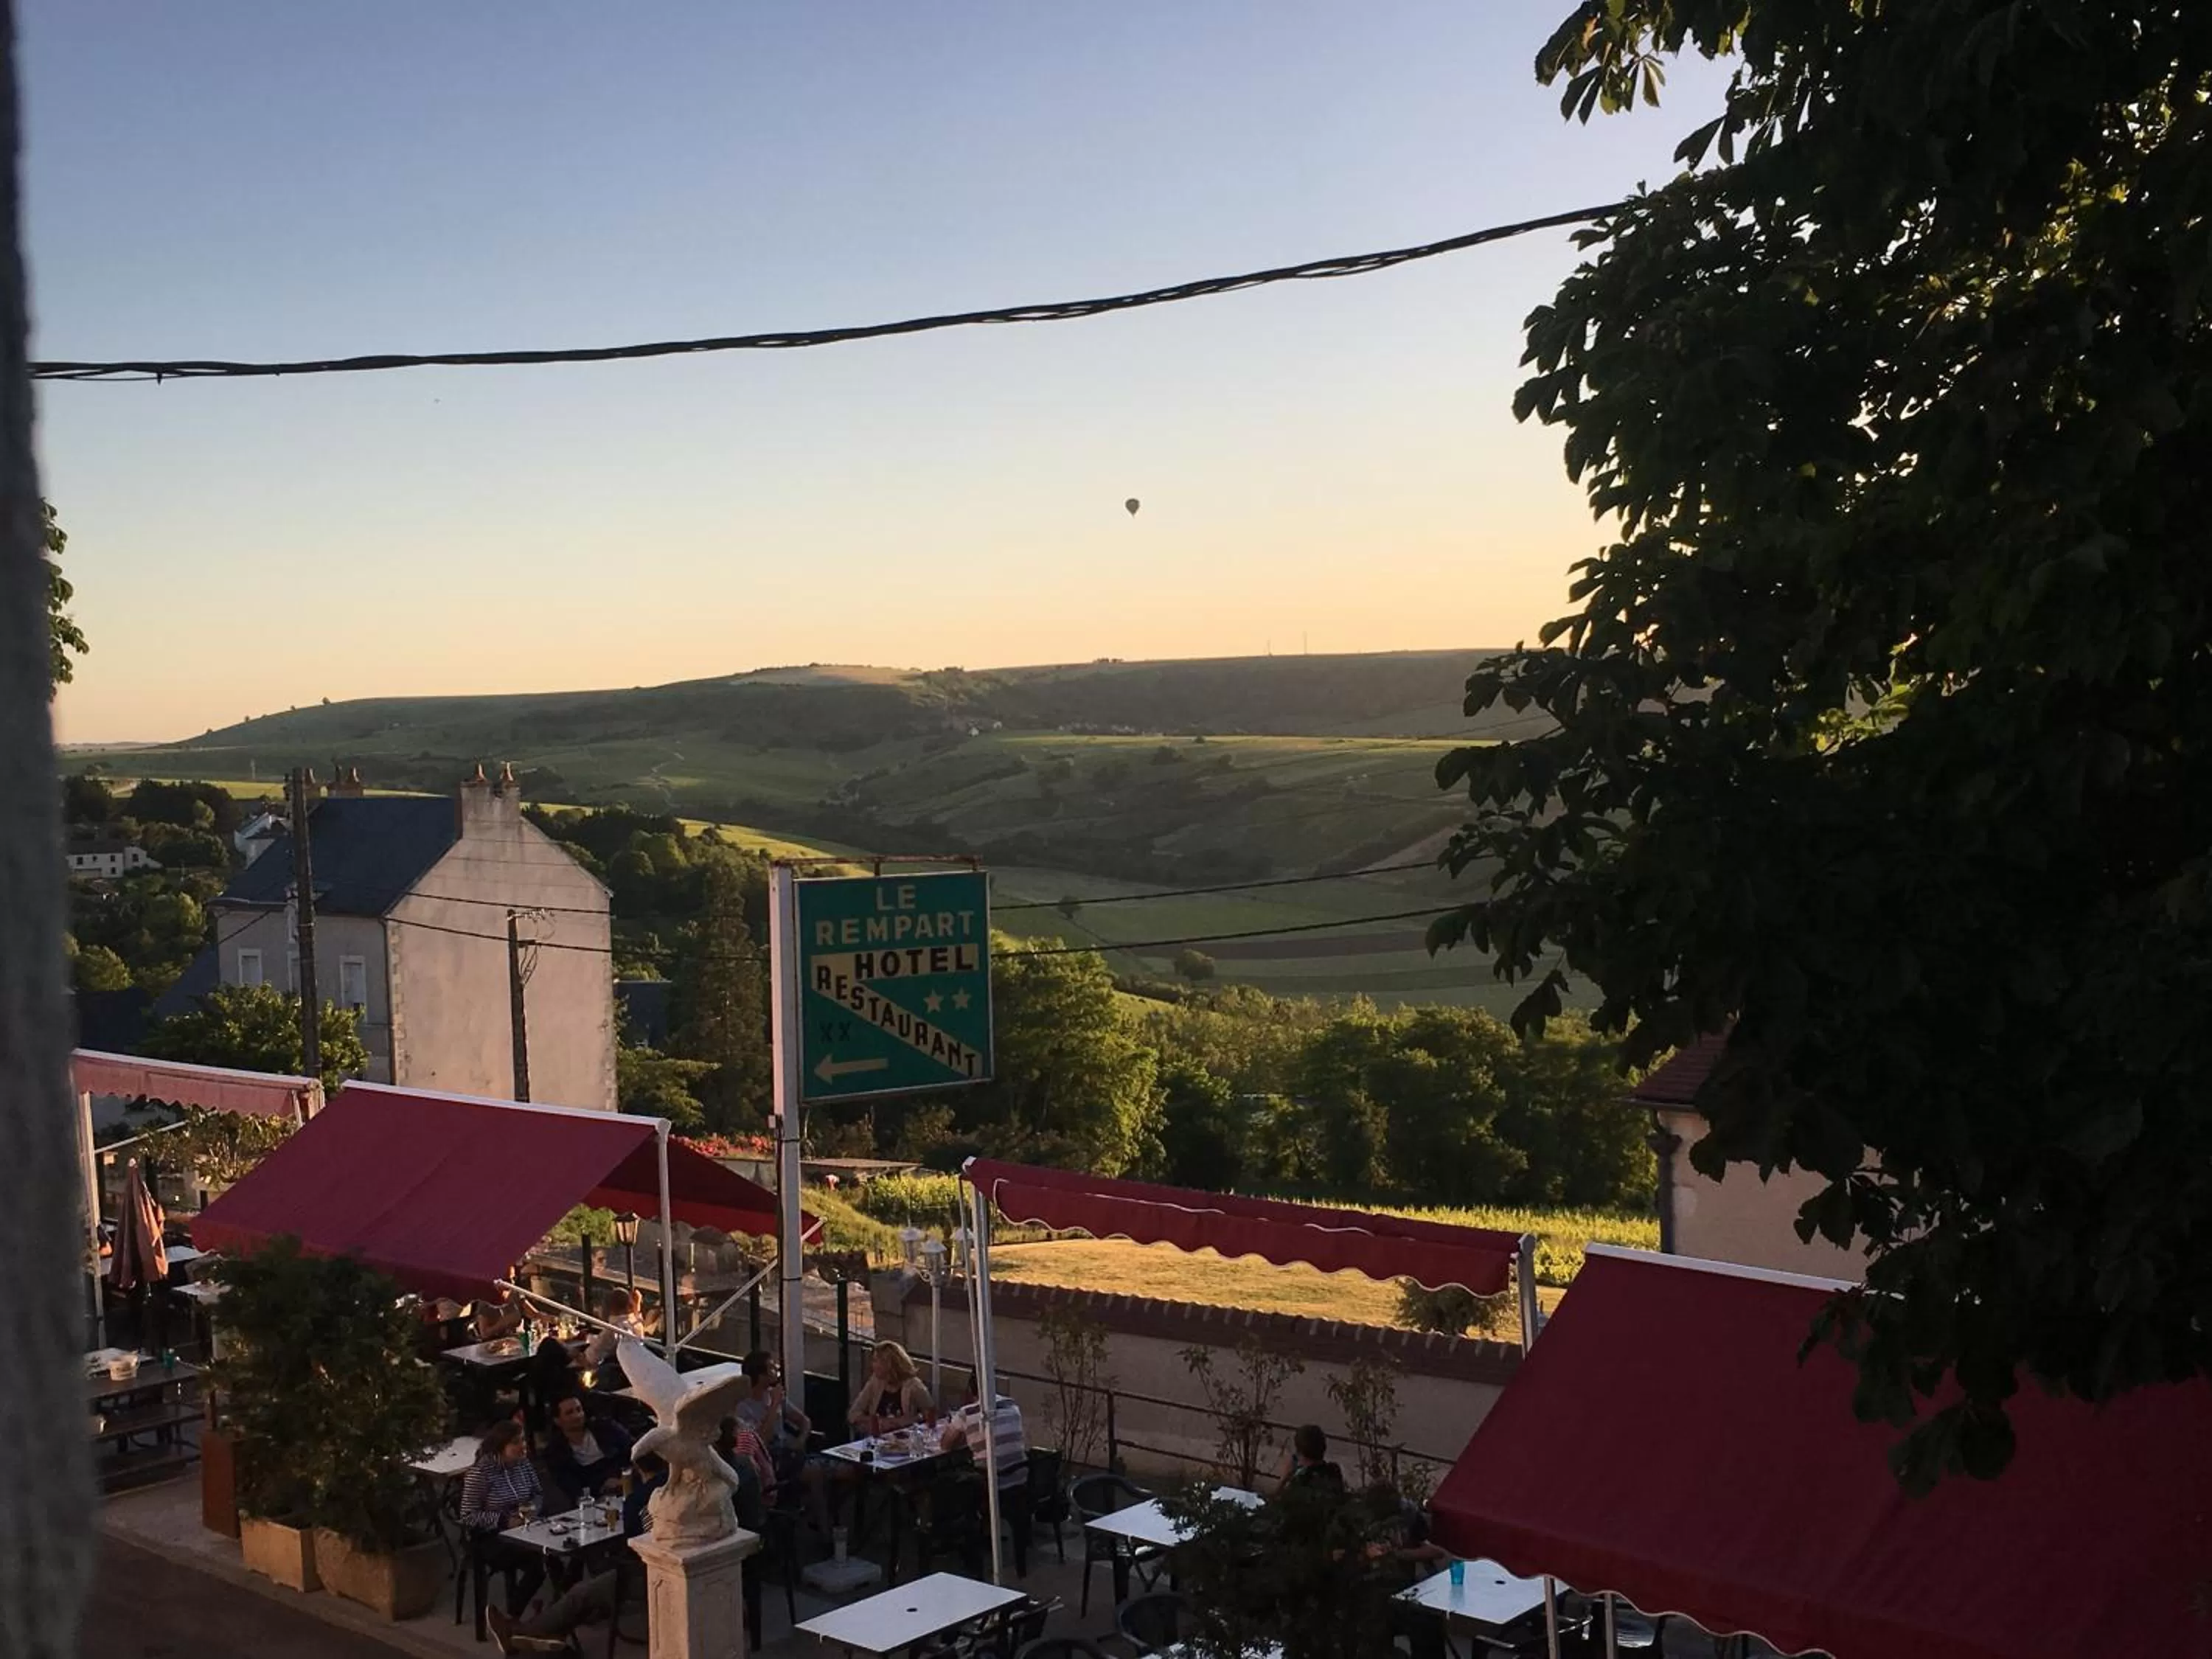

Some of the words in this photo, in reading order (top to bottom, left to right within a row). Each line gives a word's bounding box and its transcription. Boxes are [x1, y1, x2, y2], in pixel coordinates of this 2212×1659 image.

[876, 885, 917, 911] LE
[815, 911, 974, 945] REMPART
[855, 945, 973, 979] HOTEL
[817, 965, 975, 1077] RESTAURANT
